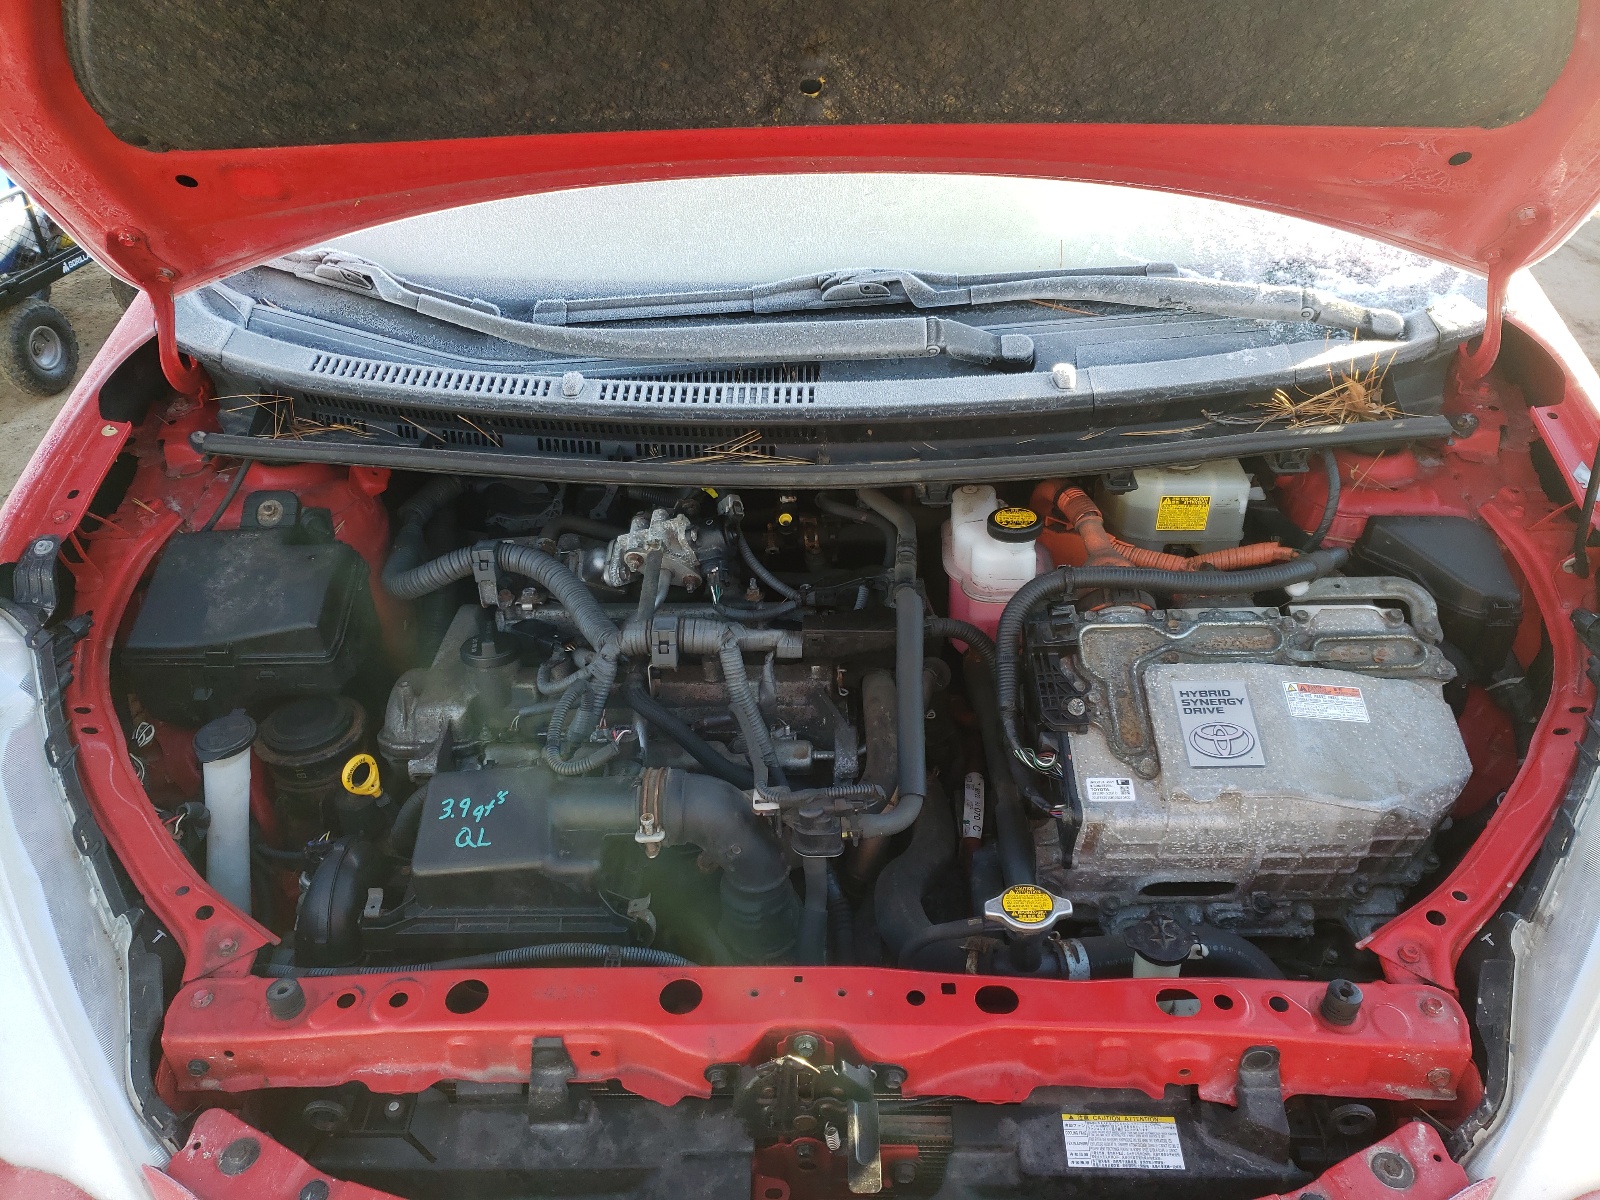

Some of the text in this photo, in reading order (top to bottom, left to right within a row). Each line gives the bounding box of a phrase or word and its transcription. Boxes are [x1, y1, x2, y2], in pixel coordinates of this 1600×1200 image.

[1179, 690, 1231, 698] HYBRID
[1181, 698, 1245, 707] SYNERGY
[1183, 707, 1225, 715] DRIVE
[439, 797, 472, 820] 3.9
